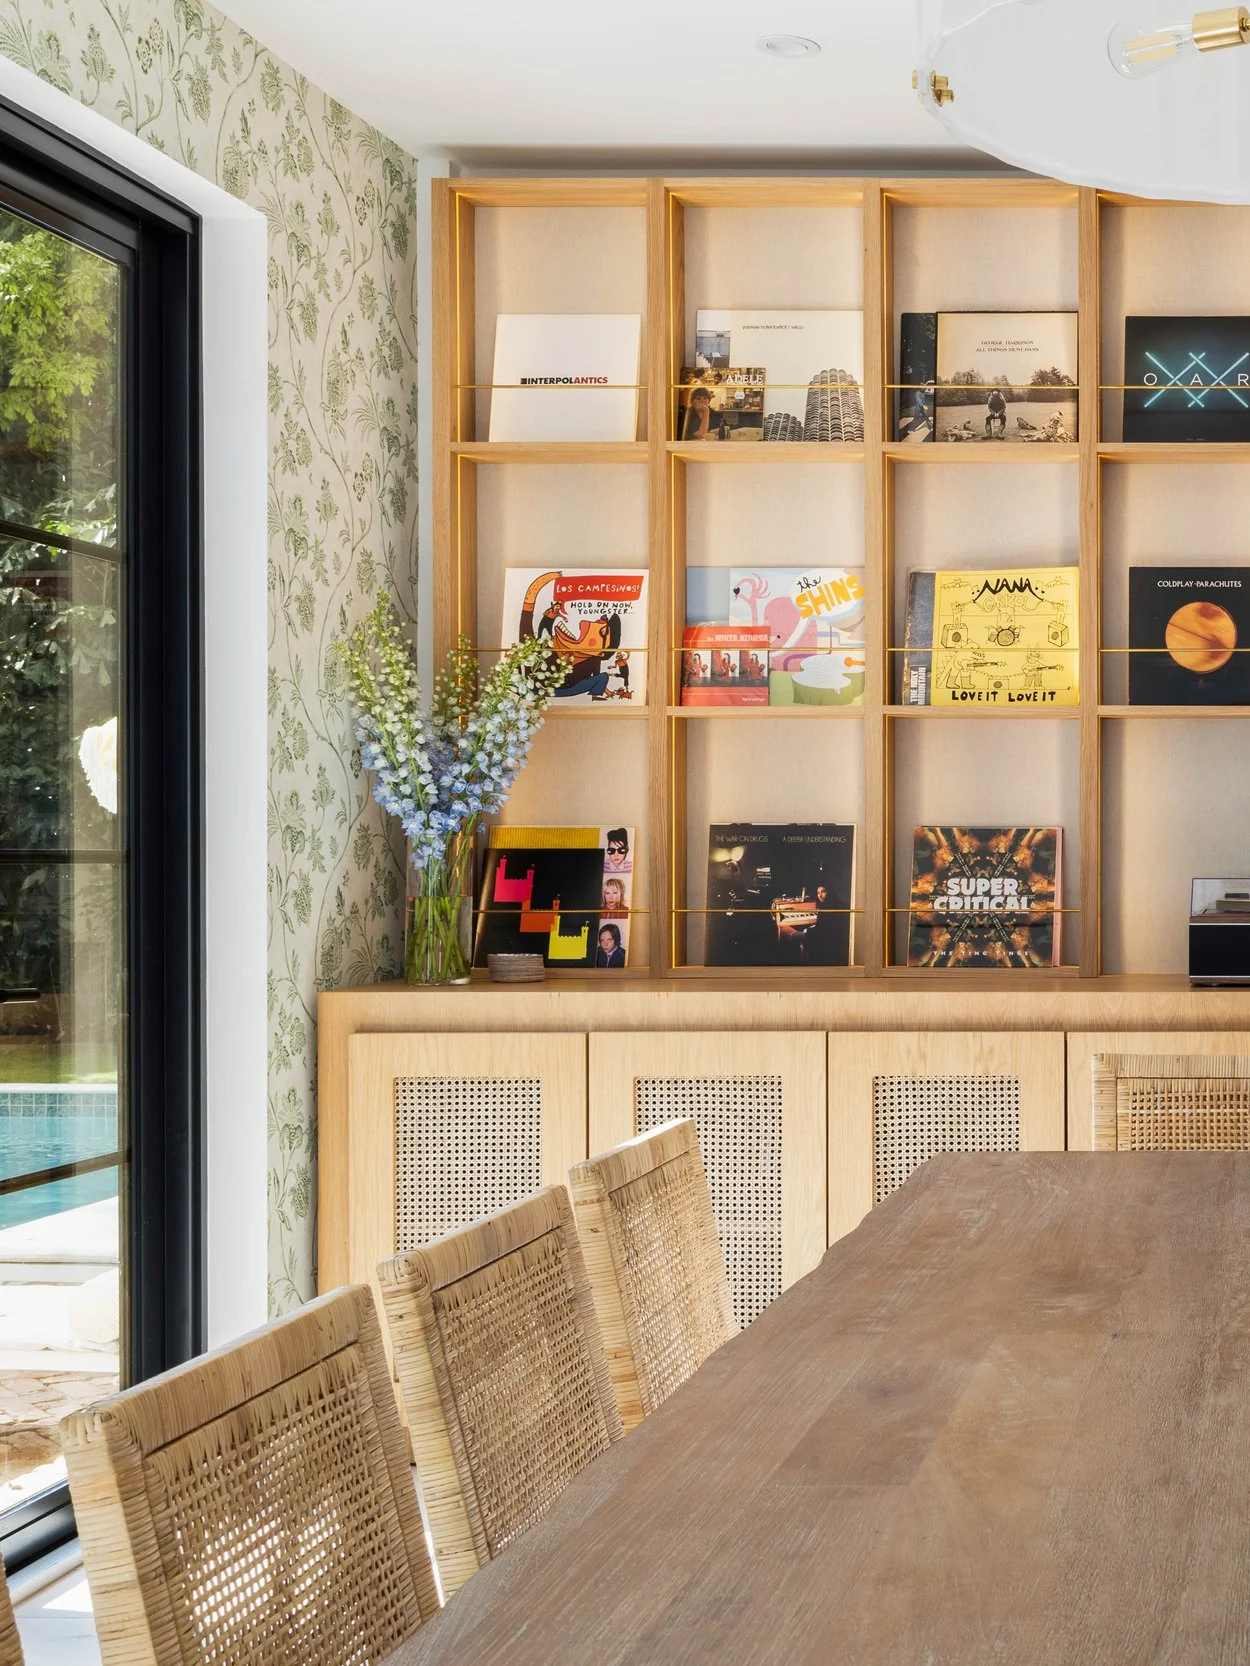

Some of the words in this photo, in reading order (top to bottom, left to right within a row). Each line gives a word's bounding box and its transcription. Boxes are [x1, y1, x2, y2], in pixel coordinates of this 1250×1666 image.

[726, 374, 764, 384] ADELE
[556, 584, 572, 592] LOS
[796, 576, 821, 592] the
[795, 574, 865, 619] SHINS
[951, 690, 982, 701] LOVE
[986, 691, 998, 701] IT
[1008, 691, 1038, 702] LOVE
[1042, 691, 1056, 701] IT
[947, 878, 1018, 895] SUPER
[934, 896, 1030, 914] CRITICAL
